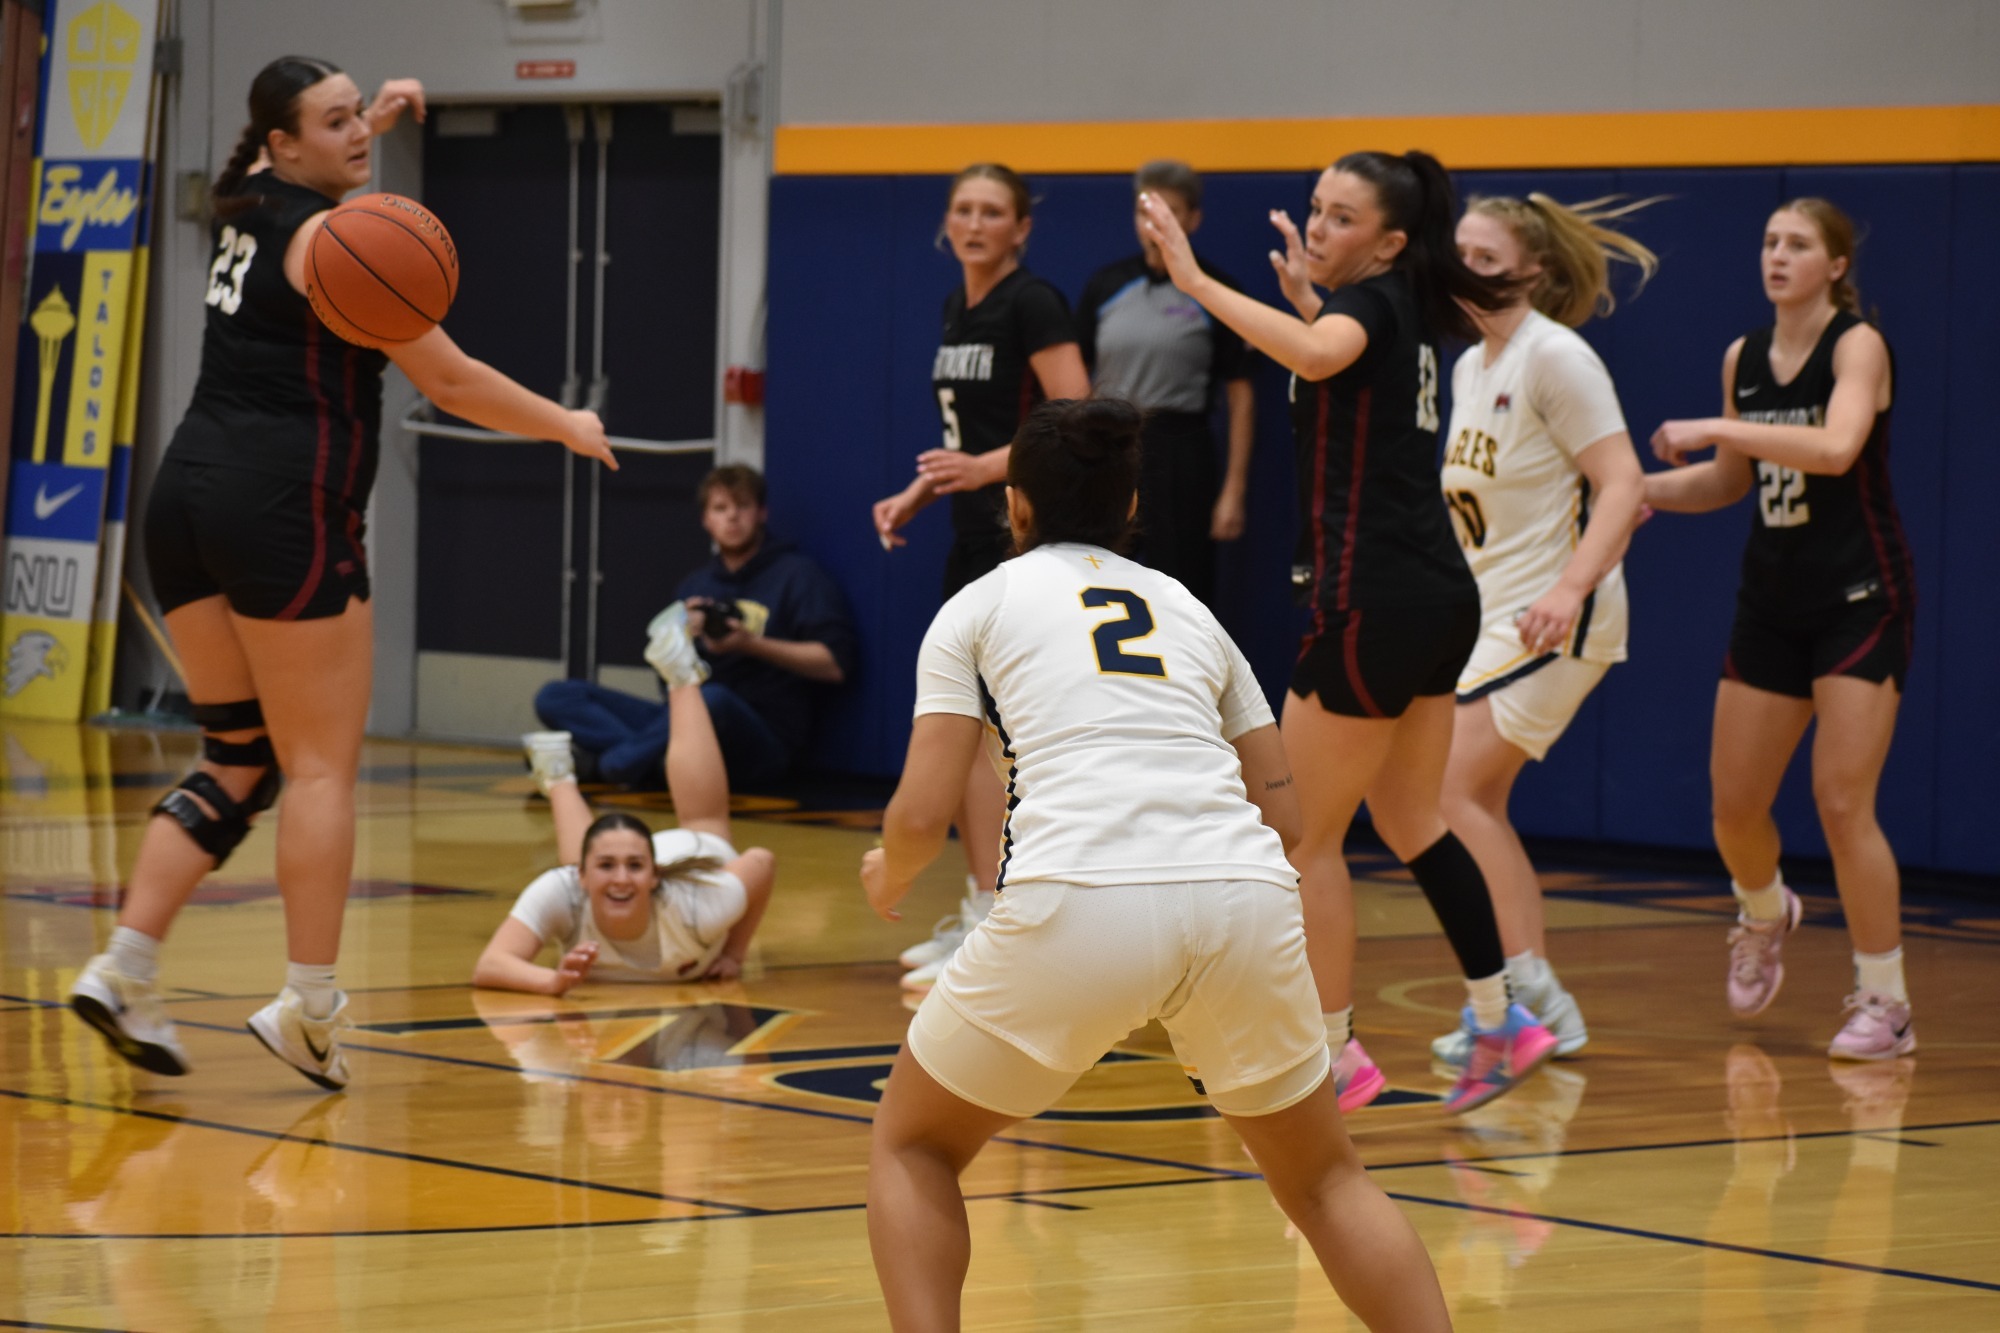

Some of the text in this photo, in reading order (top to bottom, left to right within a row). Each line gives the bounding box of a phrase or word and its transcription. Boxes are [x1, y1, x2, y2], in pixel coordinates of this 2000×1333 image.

[380, 195, 457, 269] SPALDING
[205, 225, 258, 316] 23
[83, 269, 114, 456] TALONS
[938, 388, 961, 450] 5
[1757, 460, 1810, 528] 22
[7, 552, 79, 618] NU
[1078, 585, 1169, 680] 2
